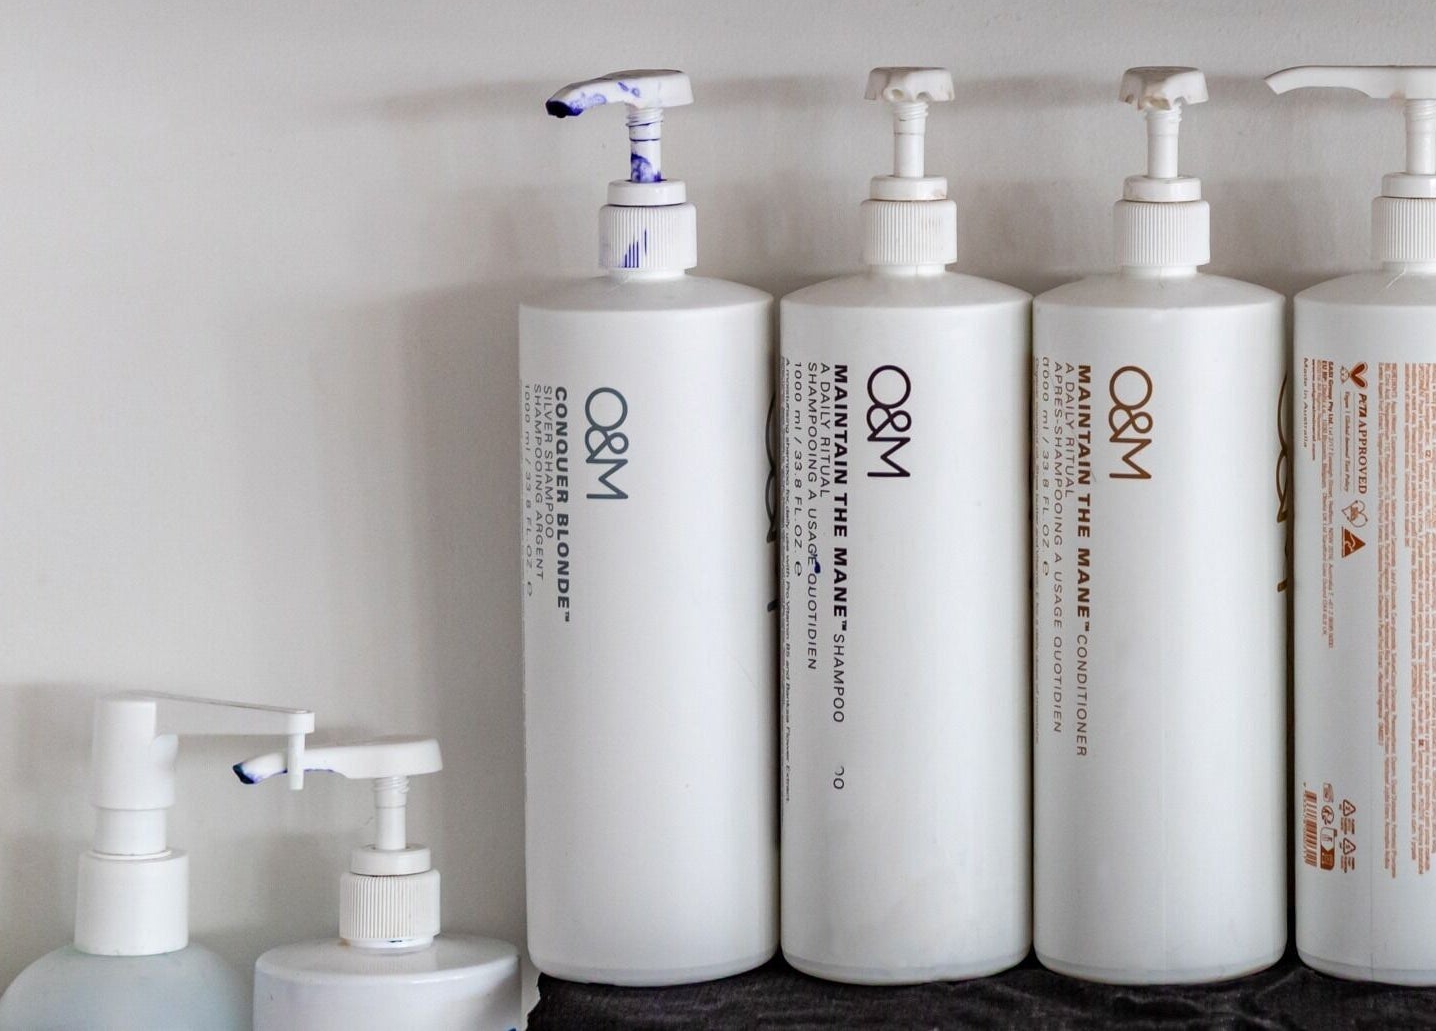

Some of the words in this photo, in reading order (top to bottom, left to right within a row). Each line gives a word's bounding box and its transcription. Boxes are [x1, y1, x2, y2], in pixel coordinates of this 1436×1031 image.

[819, 381, 831, 430] DAILY
[820, 362, 831, 375] A
[533, 383, 544, 504] SHAMPOOING
[543, 385, 554, 444] SILVER
[554, 386, 569, 504] CONQUER
[584, 386, 630, 500] O&M
[807, 361, 818, 483] SHAMPOOING
[833, 364, 848, 485] MAINTAIN
[865, 364, 913, 478] O&M
[1077, 364, 1092, 486] MAINTAIN
[1108, 365, 1154, 480] O&M
[1357, 419, 1368, 495] APPROVED
[543, 449, 555, 539] SHAMPOO
[807, 489, 818, 501] A
[819, 436, 831, 498] RITUAL
[535, 509, 544, 581] ARGENT
[807, 507, 819, 566] USAGE
[833, 492, 848, 538] THE
[1077, 492, 1091, 538] THE
[807, 572, 818, 670] QUOTIDIEN
[832, 633, 845, 723] SHAMPOO
[1076, 634, 1088, 757] CONDITIONER
